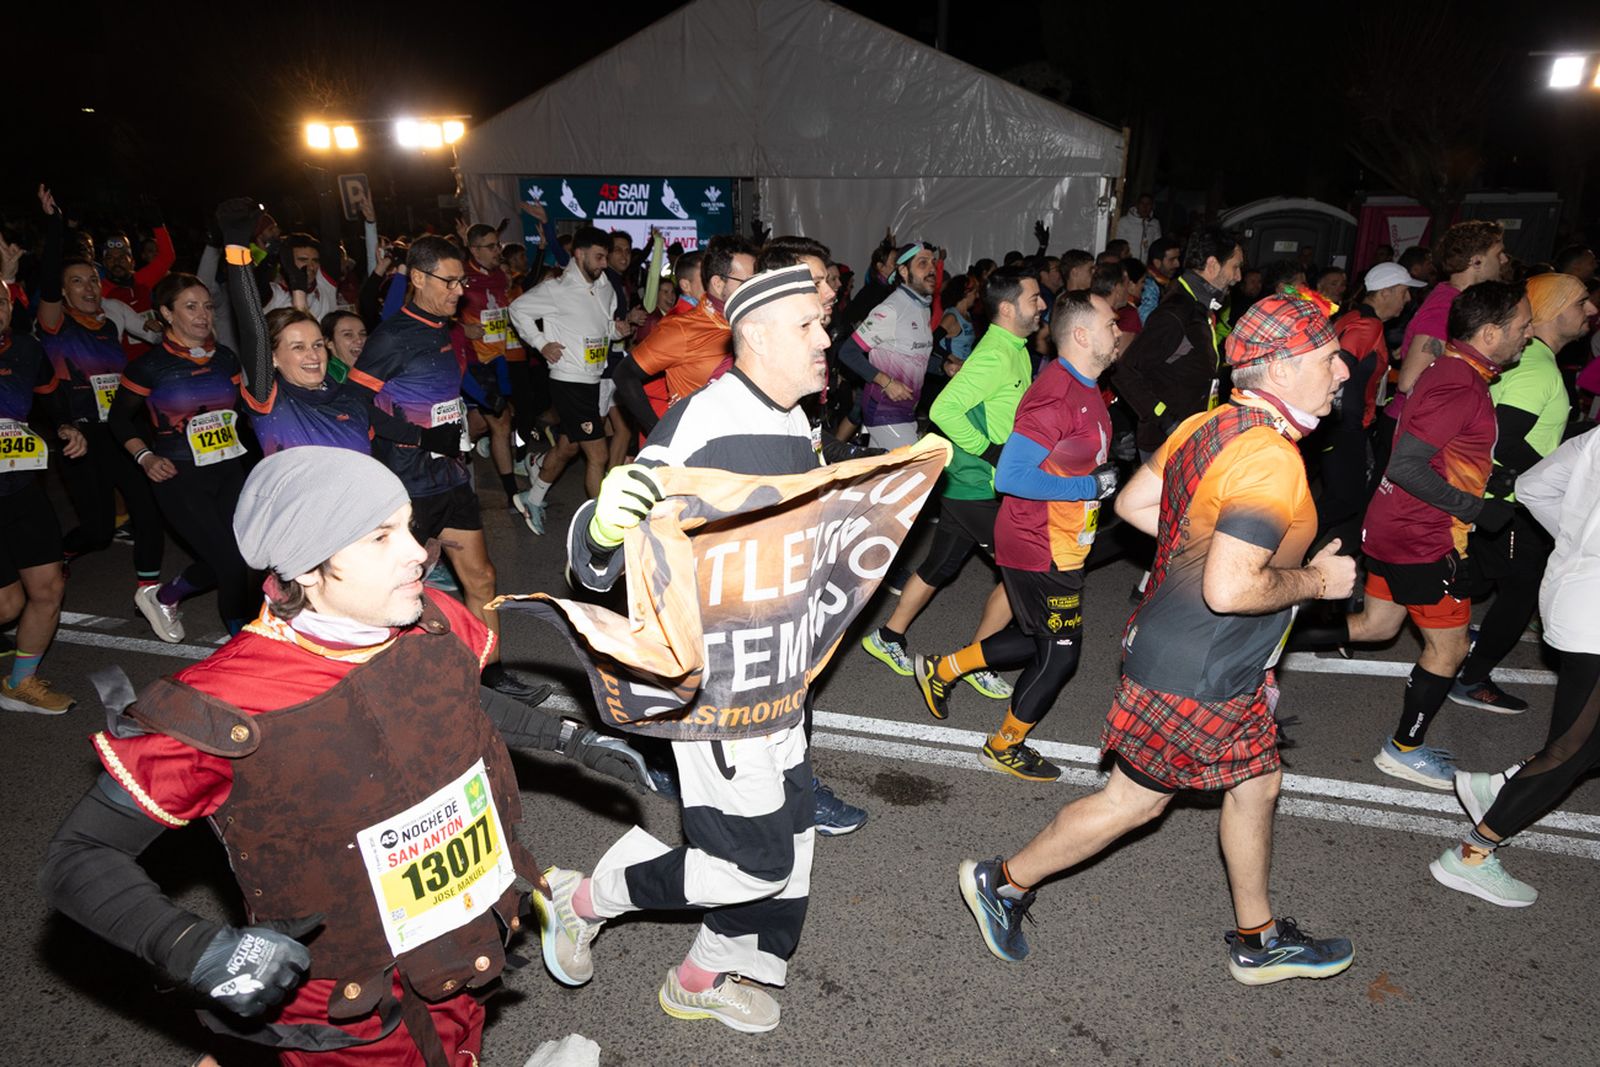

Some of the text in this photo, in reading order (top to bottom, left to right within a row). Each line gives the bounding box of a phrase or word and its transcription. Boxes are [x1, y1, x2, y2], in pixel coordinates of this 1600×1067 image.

[596, 198, 649, 216] ANTÓN
[599, 183, 650, 200] 43 SAN
[0, 437, 35, 453] 346
[197, 426, 233, 448] 12184
[401, 810, 445, 843] NOCHE
[444, 800, 459, 821] DE
[387, 844, 421, 868] SAN
[422, 815, 464, 853] ANTÓN
[401, 815, 493, 901] 13077
[432, 865, 486, 906] JOSE MANUEL
[227, 933, 256, 976] ANTÓN
[246, 936, 265, 963] SAN
